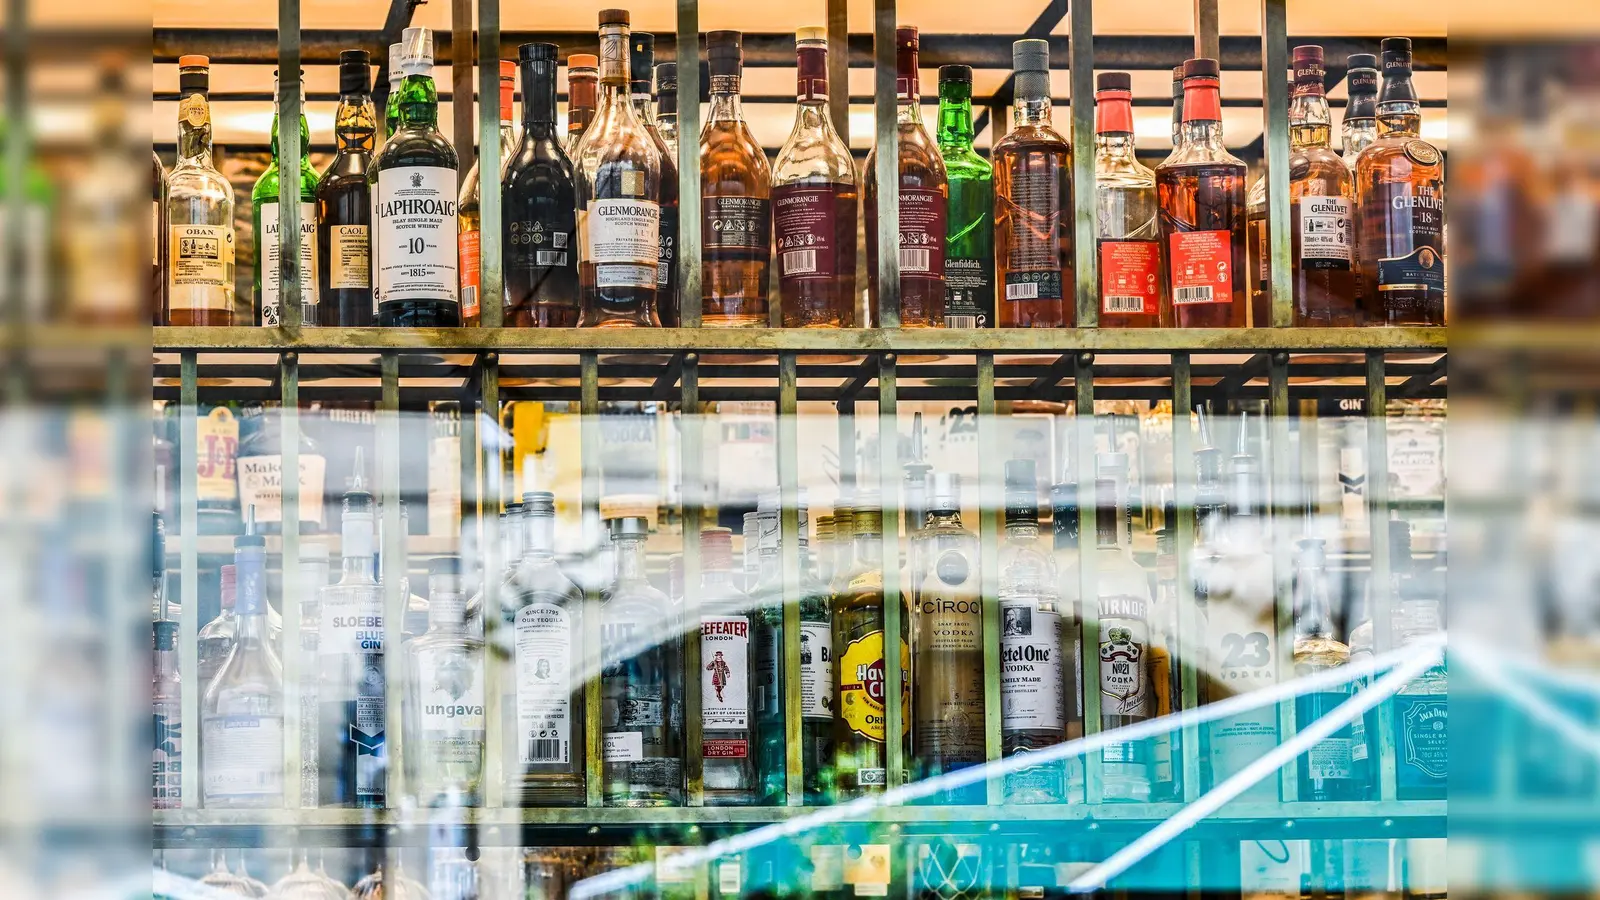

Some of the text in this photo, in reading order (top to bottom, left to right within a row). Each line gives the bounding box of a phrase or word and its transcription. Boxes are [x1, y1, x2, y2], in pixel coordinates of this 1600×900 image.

[1418, 186, 1434, 196] THE
[380, 199, 456, 218] LAPHROAIG
[1311, 204, 1347, 214] GLENLIVET
[1392, 196, 1443, 211] GLENLIVE
[1421, 212, 1432, 223] 18
[266, 224, 315, 234] LAAIG
[408, 237, 425, 254] 10
[410, 268, 426, 277] 1815
[1340, 399, 1362, 410] GIN
[361, 640, 381, 649] GIN
[1221, 632, 1271, 668] 23
[1000, 643, 1049, 662] etel One
[426, 705, 483, 718] ungava
[1419, 708, 1434, 722] JACK
